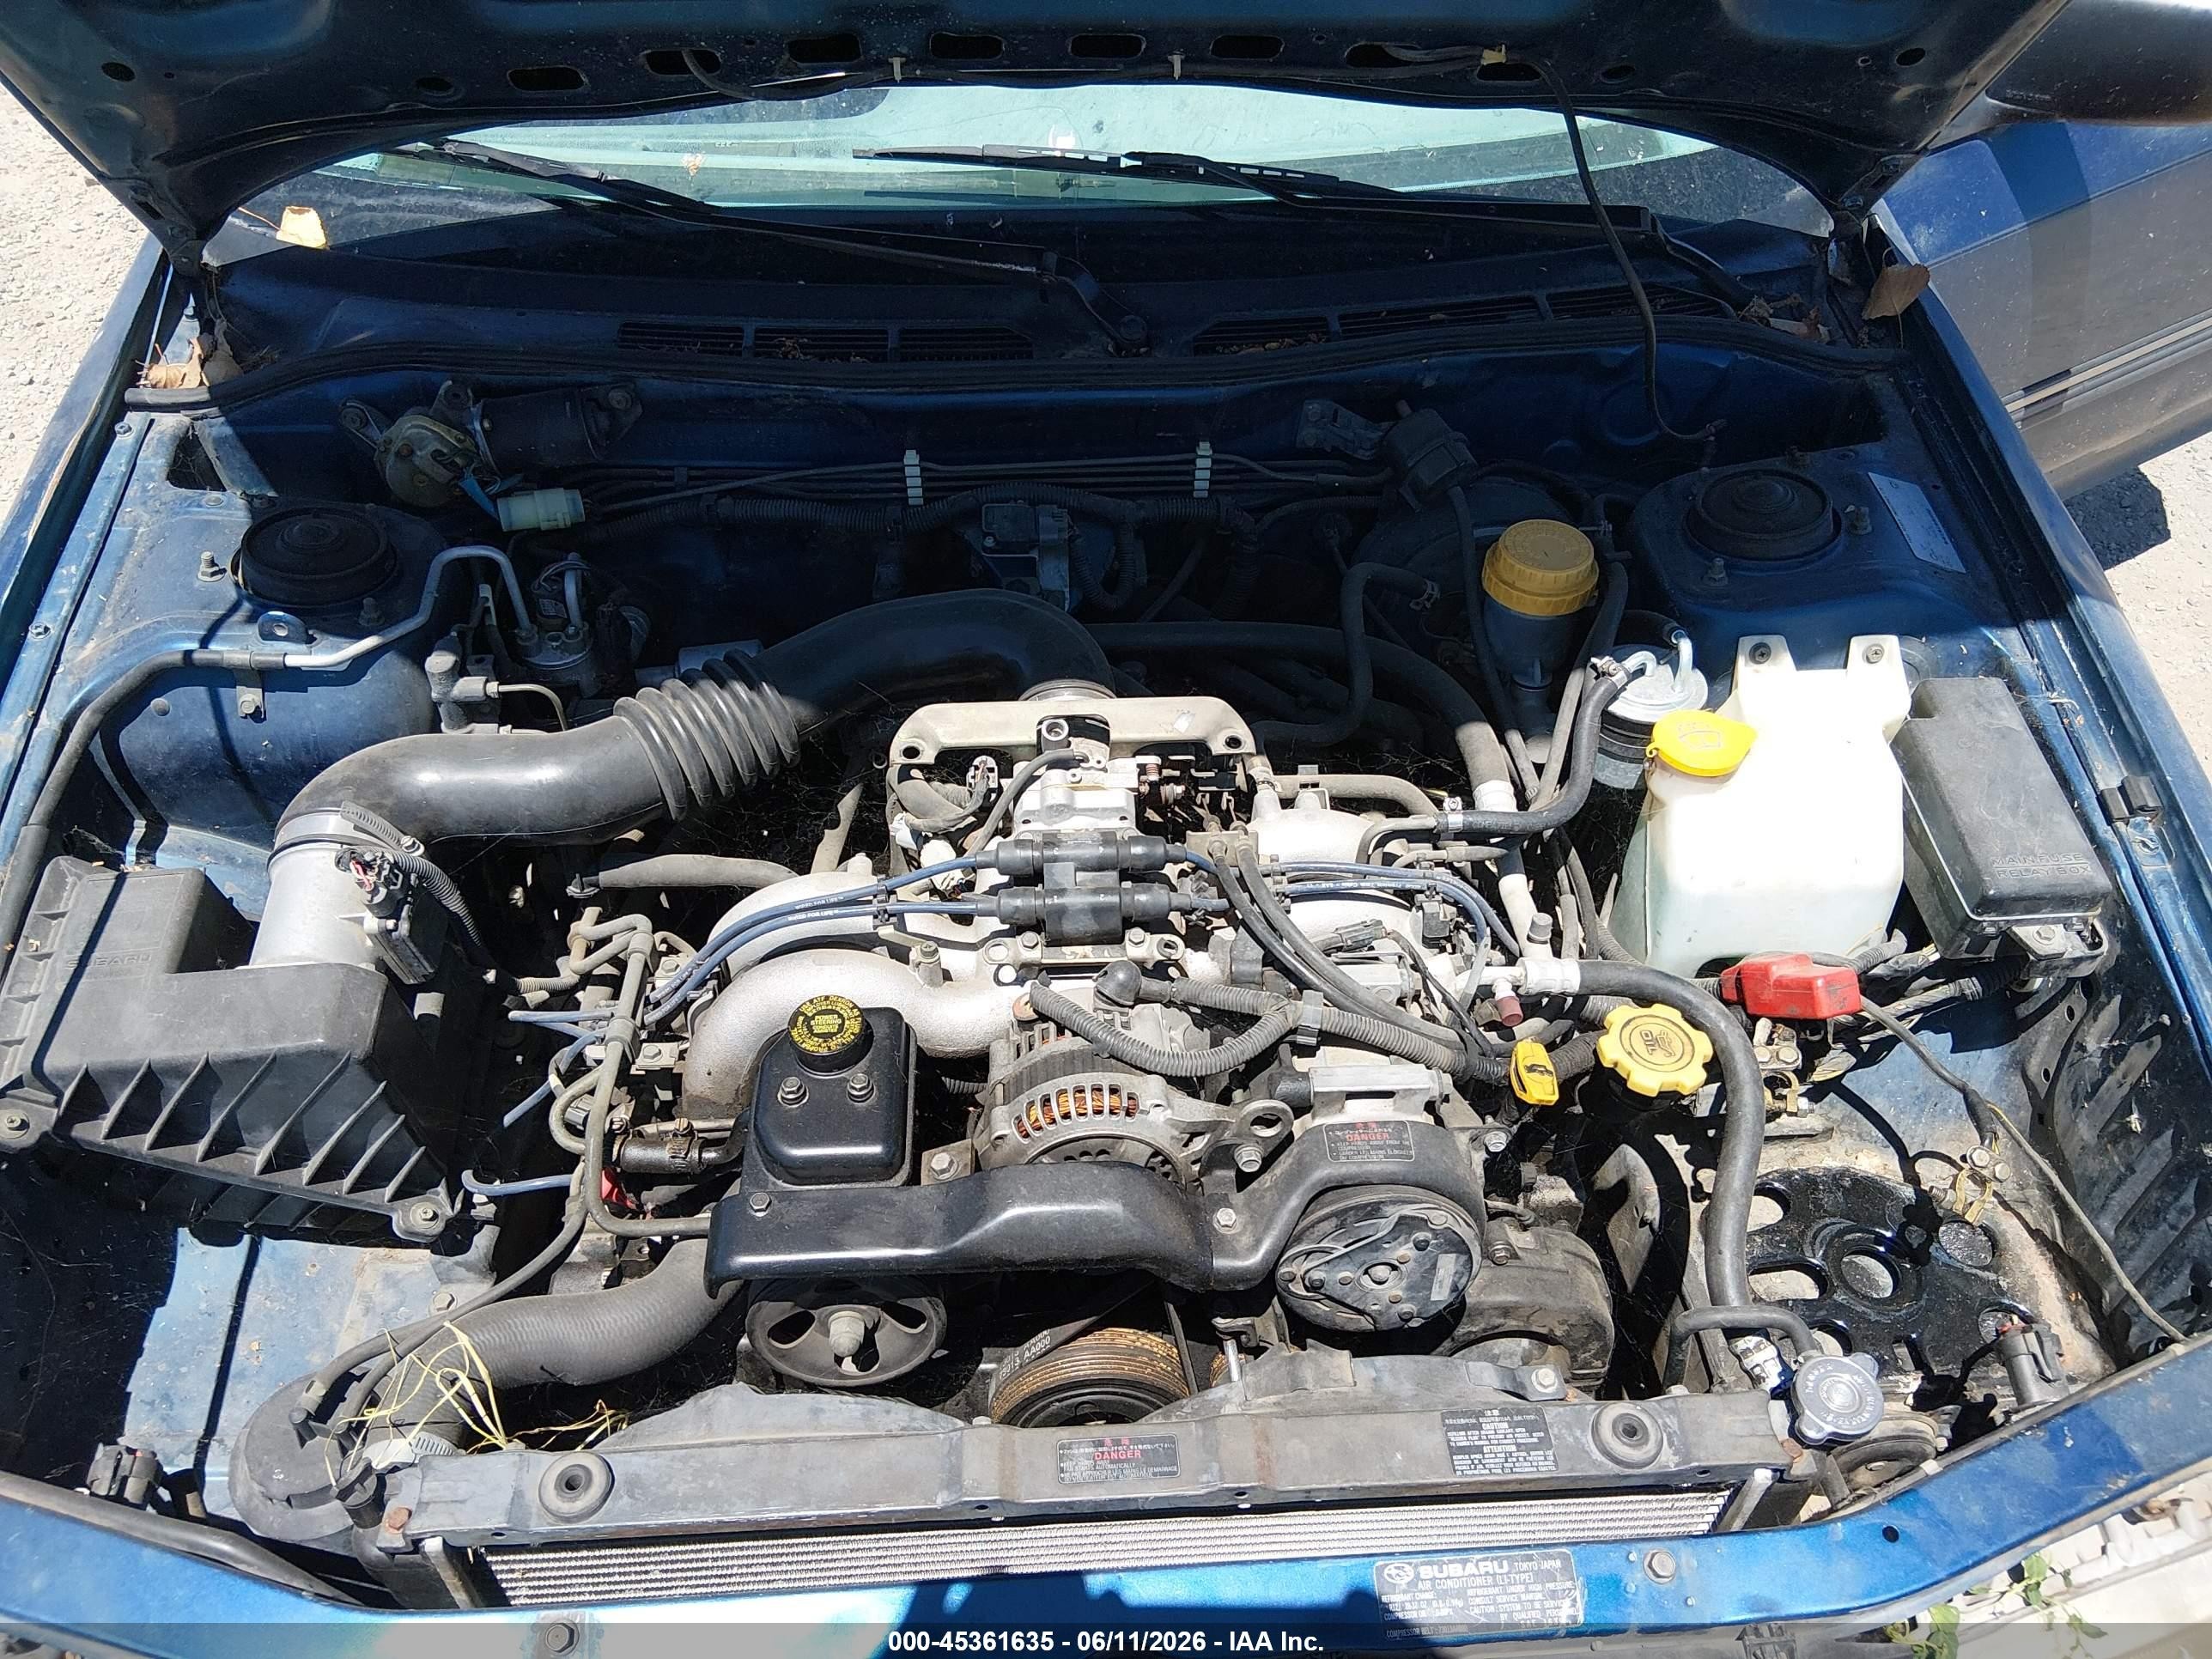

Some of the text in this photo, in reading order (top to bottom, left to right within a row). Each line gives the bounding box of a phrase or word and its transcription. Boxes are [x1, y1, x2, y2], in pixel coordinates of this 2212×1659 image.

[1992, 852, 2084, 866] MAIN FUSE
[1997, 865, 2092, 878] RELAY BOX
[1639, 1029, 1658, 1055] OIL
[1346, 1133, 1389, 1142] DANGER
[1094, 1449, 1141, 1461] DANGER
[1483, 1444, 1517, 1454] ATTENTION
[1418, 1559, 1561, 1580] SUBARU TOKYO JAPAN
[1418, 1579, 1432, 1590] AIR
[1435, 1575, 1492, 1589] CONDITIONER
[1495, 1594, 1518, 1604] SERVICE
[1523, 1601, 1532, 1610] TO
[1386, 1627, 1420, 1638] COMPRESSOR
